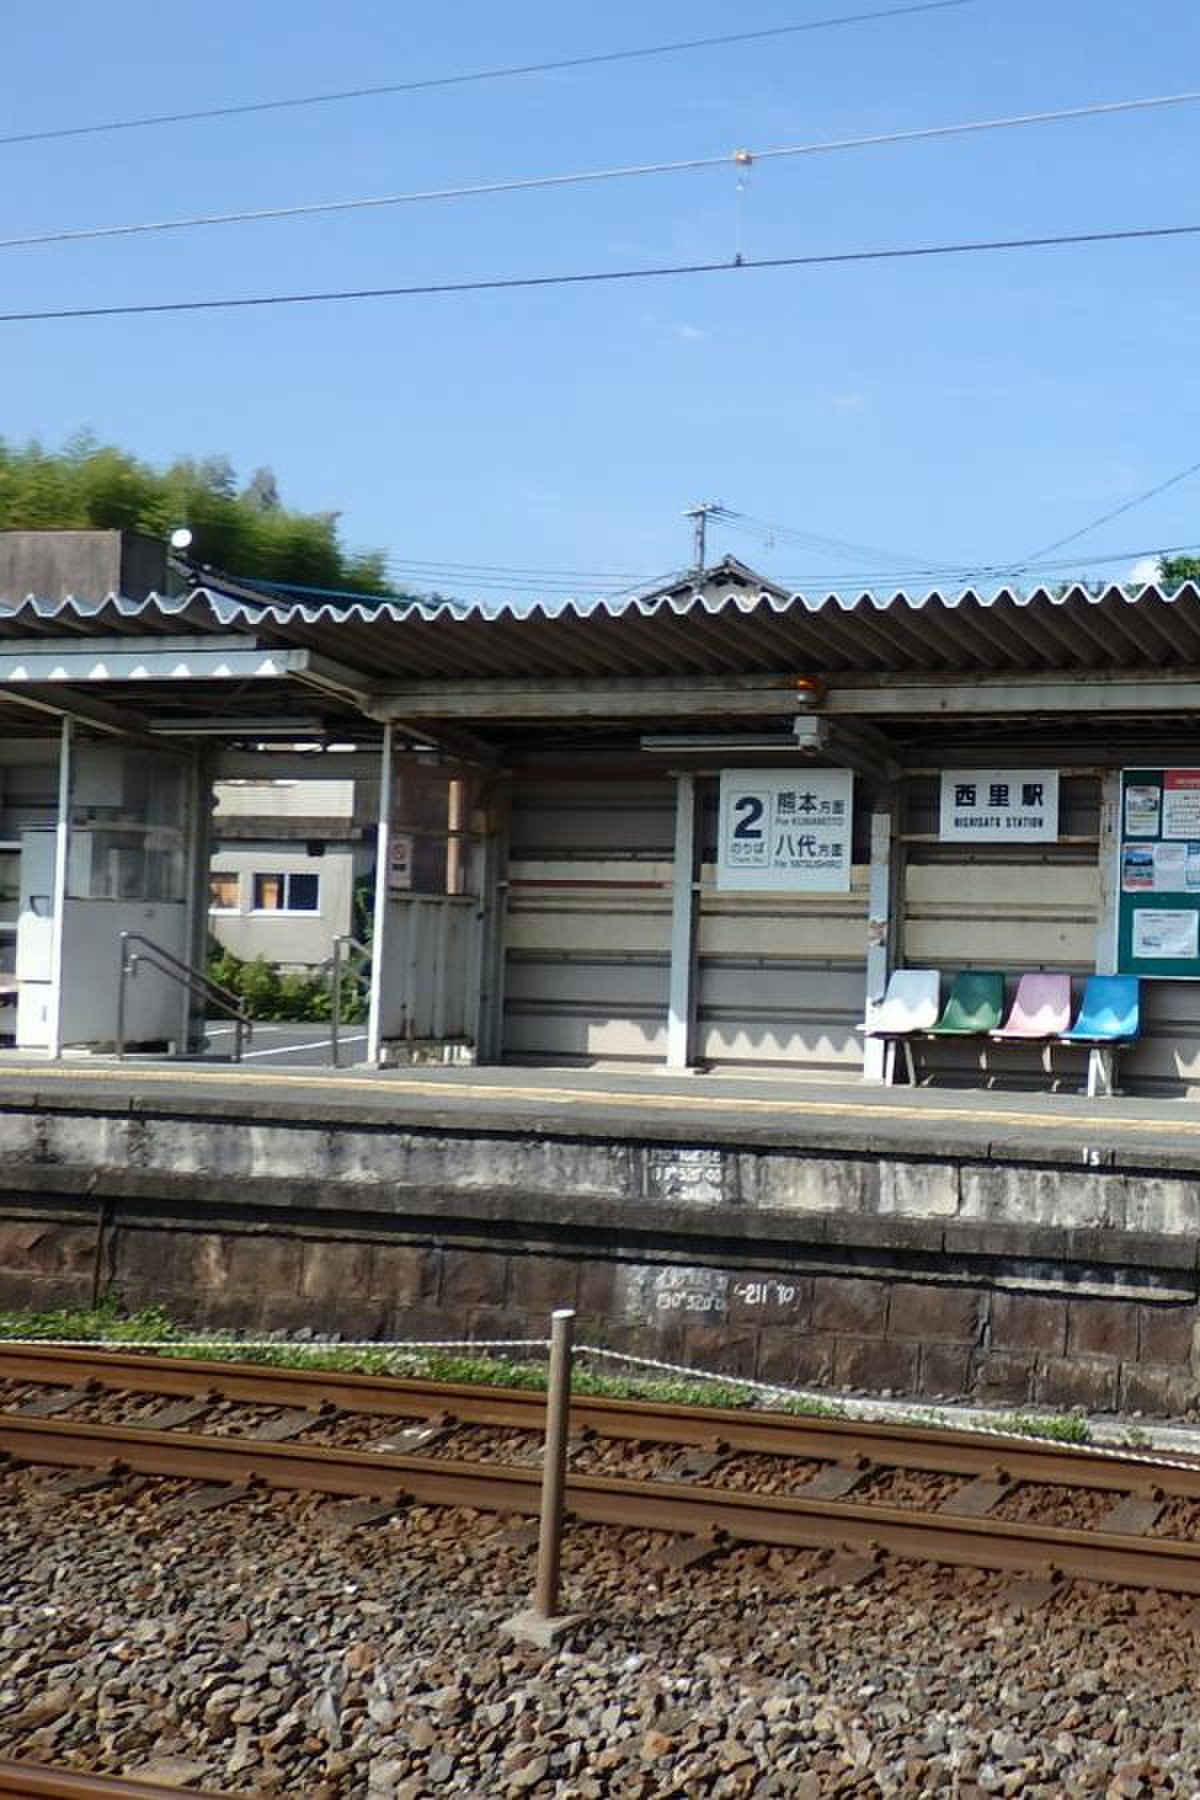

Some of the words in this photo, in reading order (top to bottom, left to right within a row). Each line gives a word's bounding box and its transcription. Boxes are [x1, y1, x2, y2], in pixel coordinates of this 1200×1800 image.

[954, 784, 1043, 807] 西里駅
[733, 796, 763, 838] 2
